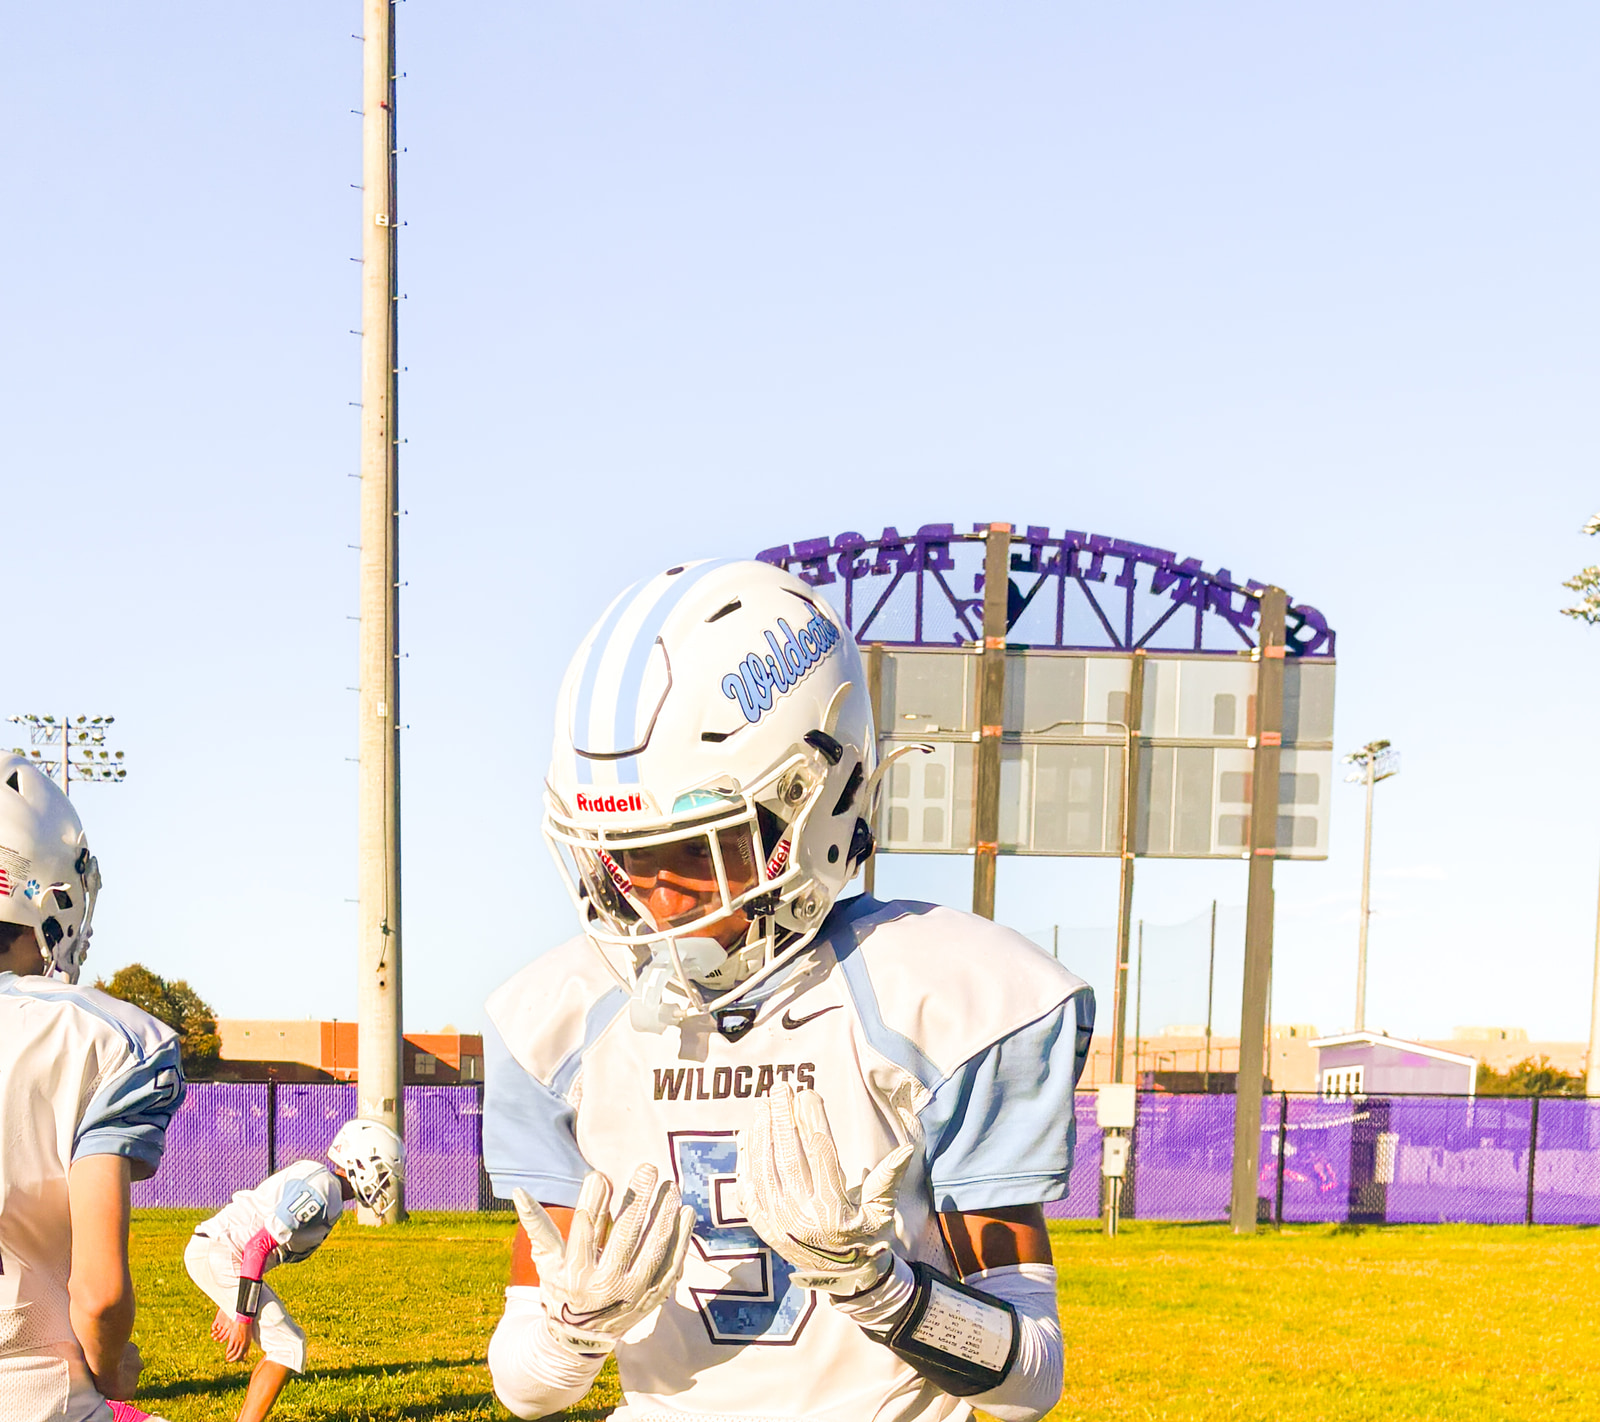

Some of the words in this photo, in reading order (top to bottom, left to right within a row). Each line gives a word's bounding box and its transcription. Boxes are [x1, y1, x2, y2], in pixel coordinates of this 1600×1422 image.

[576, 792, 642, 812] Riddell
[653, 1062, 816, 1101] WILDCATS
[287, 1190, 322, 1224] 18
[667, 1130, 818, 1346] 5
